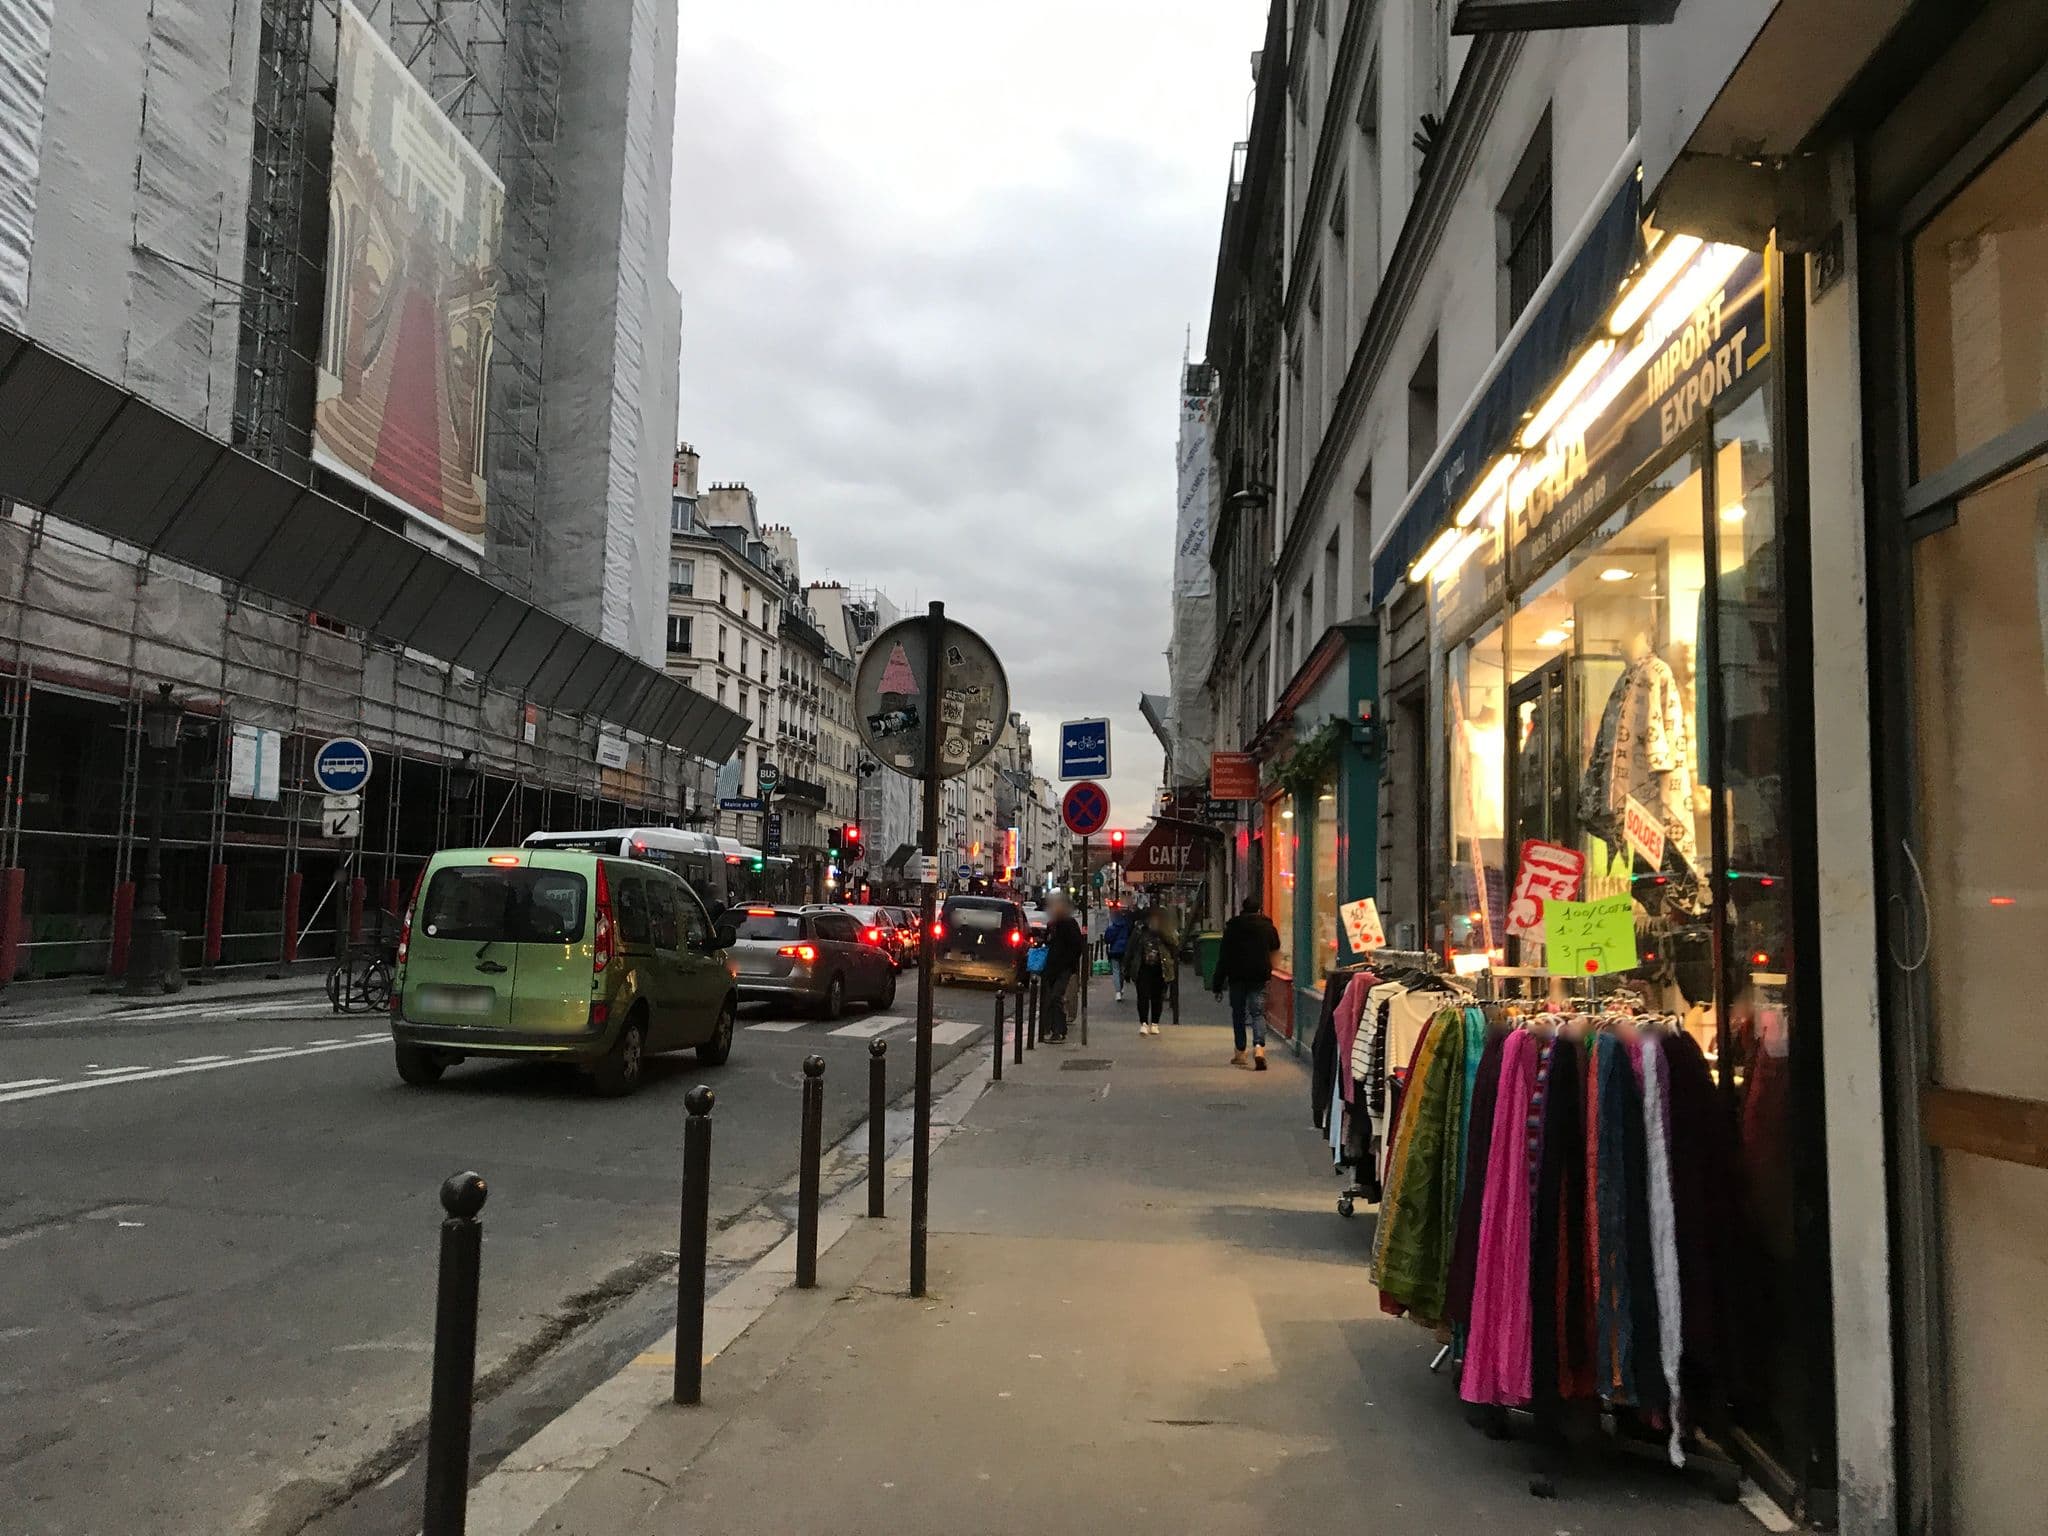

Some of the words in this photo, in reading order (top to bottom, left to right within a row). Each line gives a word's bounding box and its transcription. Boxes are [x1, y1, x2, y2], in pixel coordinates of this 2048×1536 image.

[1648, 290, 1725, 405] IMPORT
[1661, 326, 1747, 445] EXPORT
[760, 769, 777, 778] BUS
[1626, 809, 1663, 859] SOLDES
